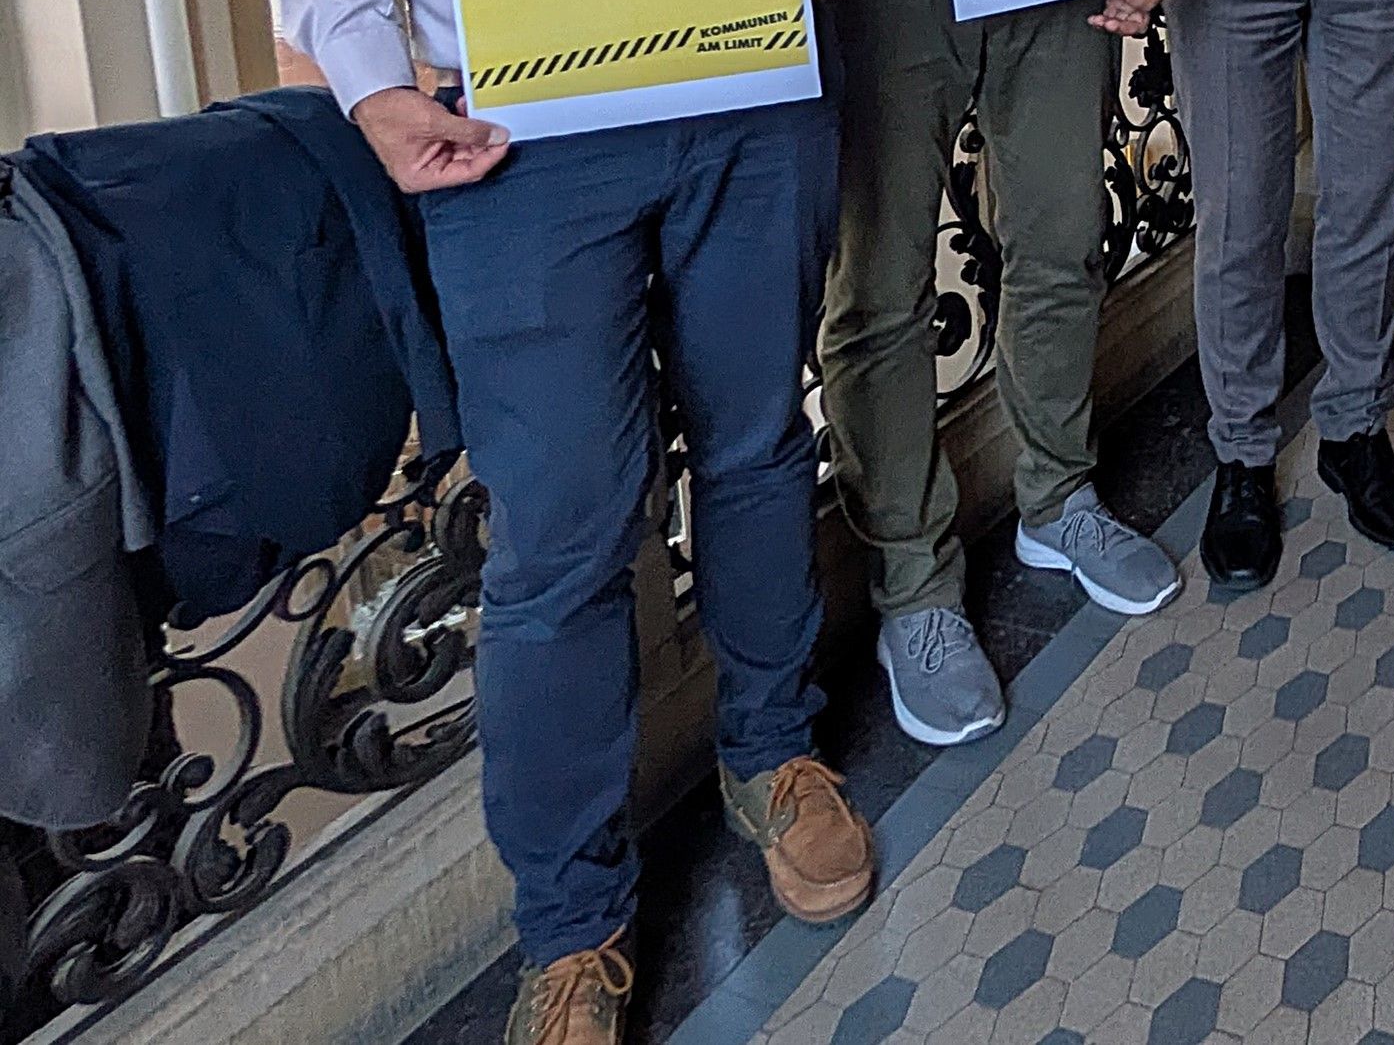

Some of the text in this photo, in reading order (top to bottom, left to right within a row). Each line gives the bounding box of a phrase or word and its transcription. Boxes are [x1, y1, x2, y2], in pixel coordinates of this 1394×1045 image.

[700, 11, 788, 39] KOMMUNEN
[697, 36, 763, 54] AM LIMIT
